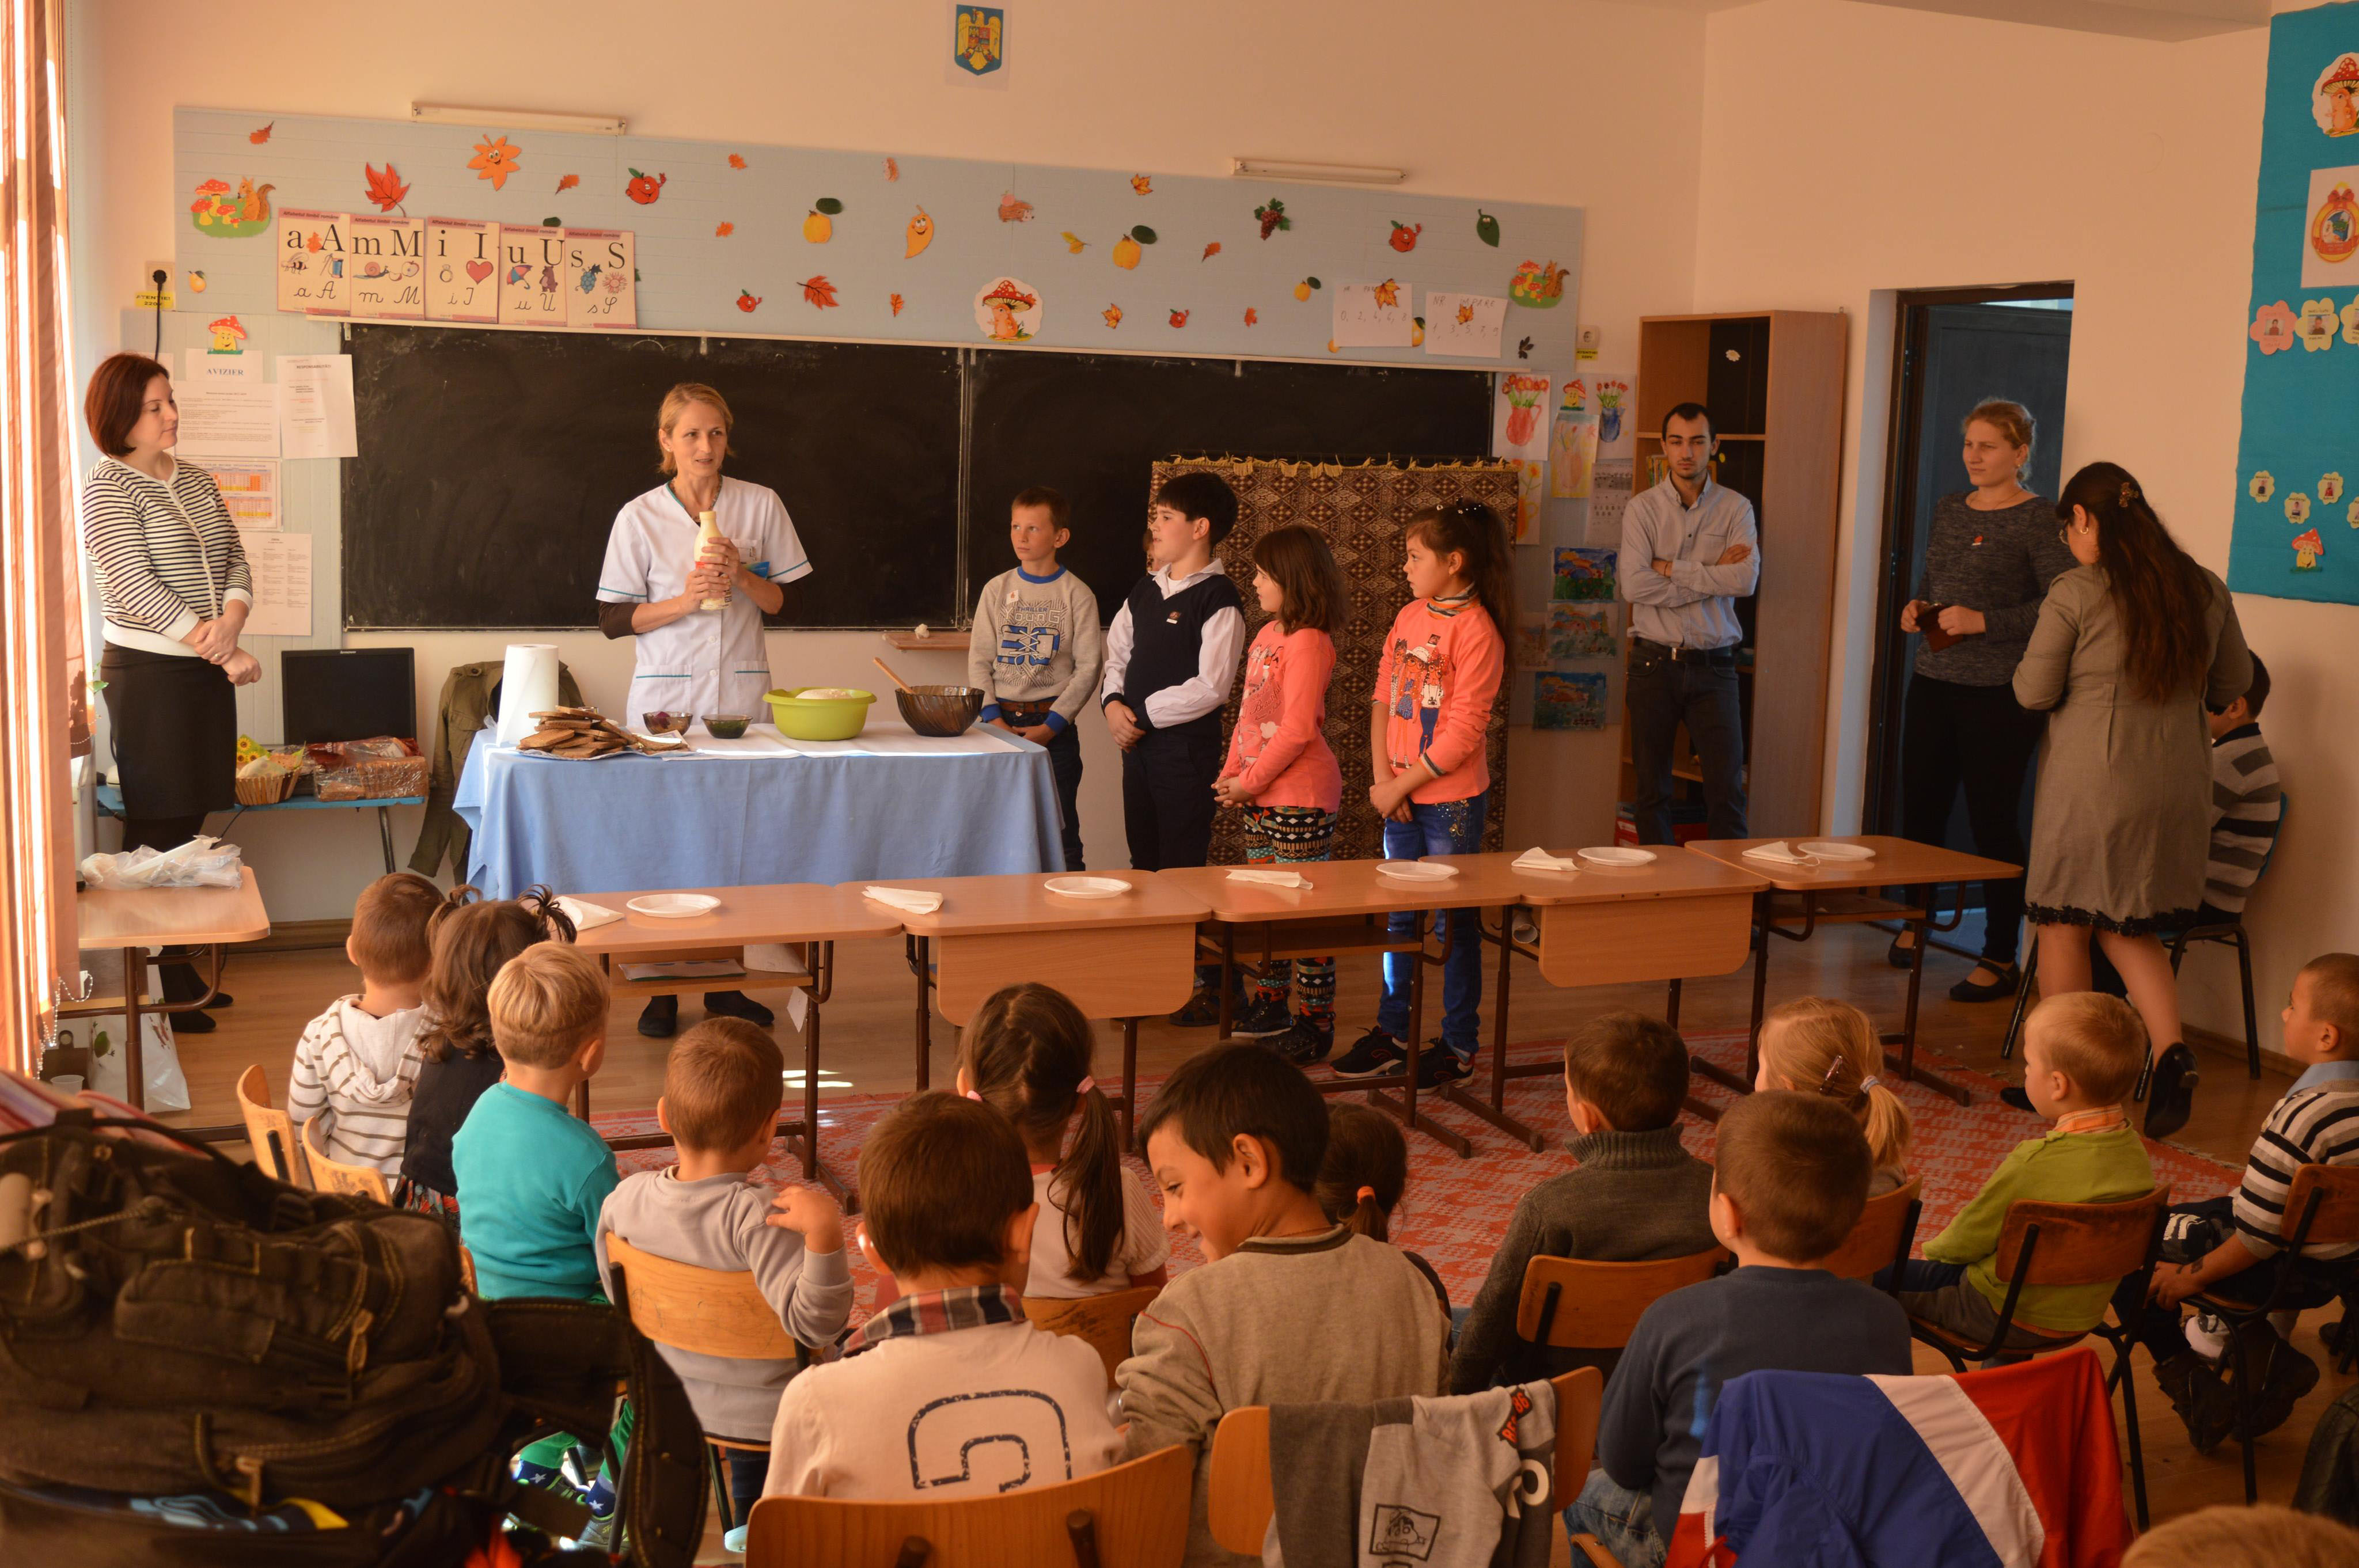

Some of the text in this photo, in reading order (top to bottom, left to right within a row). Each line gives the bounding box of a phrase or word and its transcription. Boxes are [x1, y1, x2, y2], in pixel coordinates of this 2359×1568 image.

[287, 224, 346, 252] a A
[352, 229, 423, 257] m M
[438, 230, 488, 259] i I
[507, 238, 564, 266] u U
[571, 242, 625, 269] s S
[293, 280, 336, 299] a A
[358, 286, 420, 305] m M
[206, 368, 245, 376] AVIZIER
